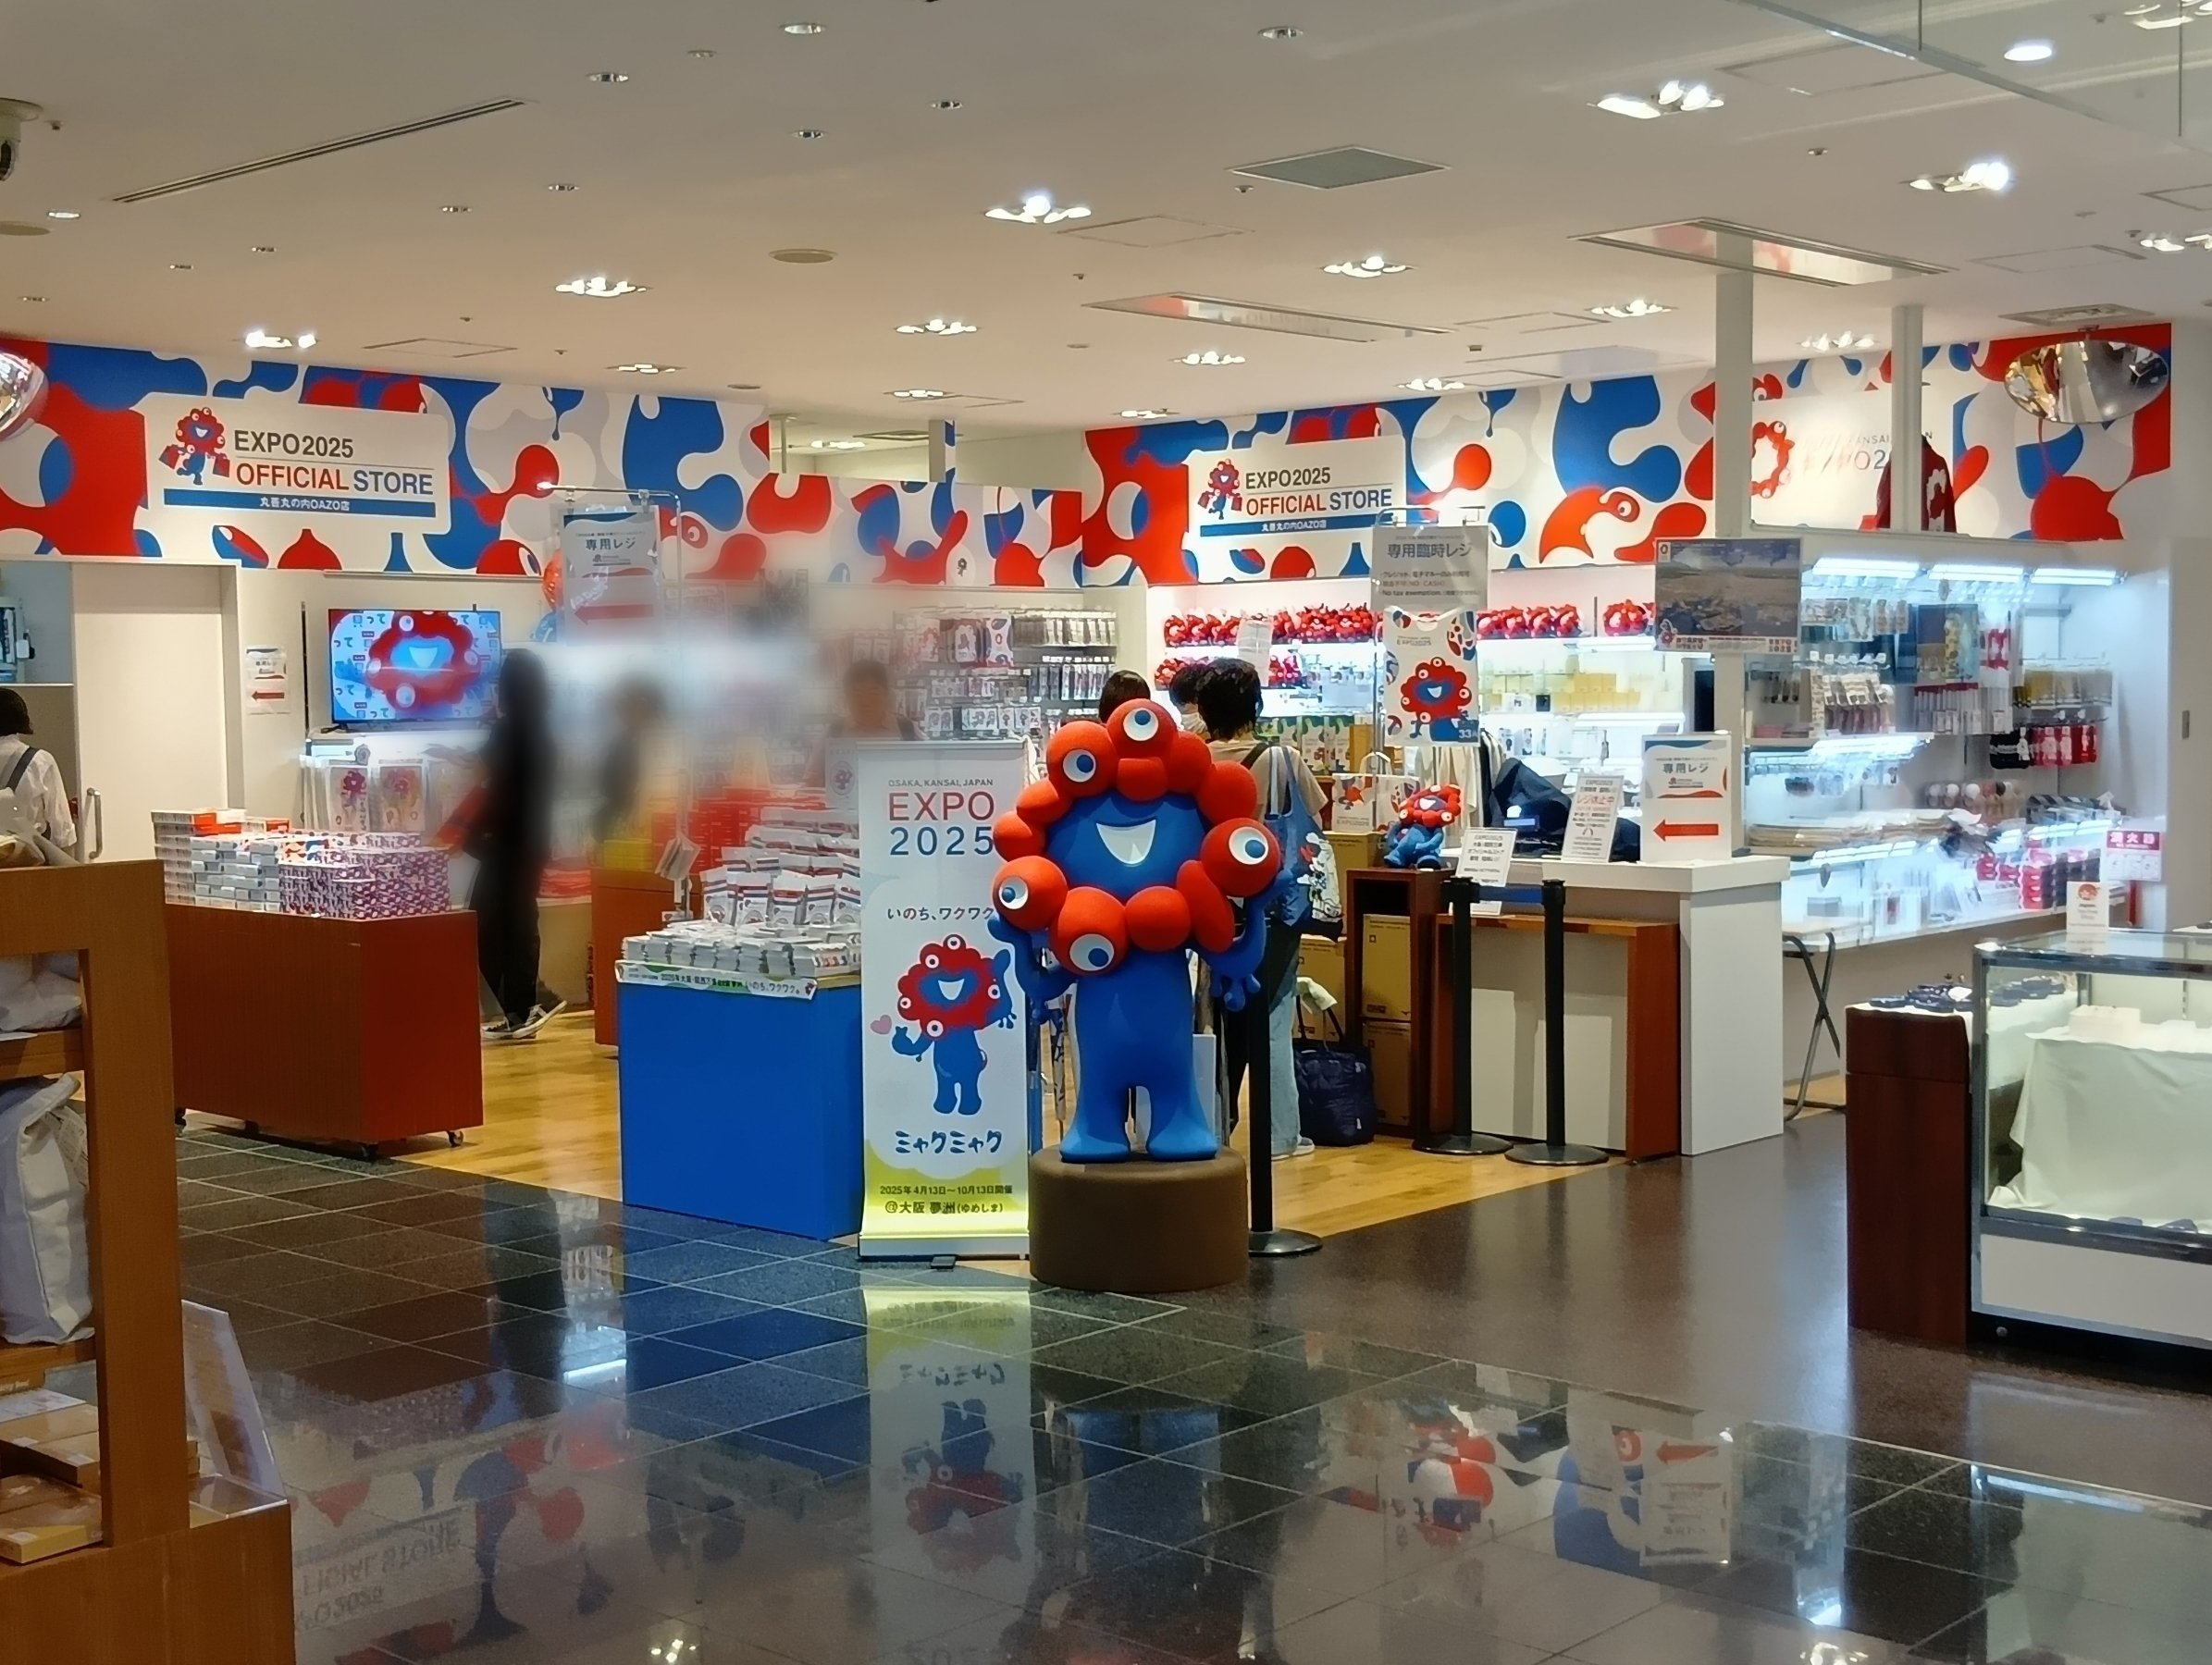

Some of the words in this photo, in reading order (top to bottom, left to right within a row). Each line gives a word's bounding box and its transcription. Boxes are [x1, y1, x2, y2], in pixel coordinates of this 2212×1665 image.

[234, 429, 353, 458] EXPO2025
[236, 462, 349, 491] OFFICIAL
[352, 471, 434, 495] STORE
[1245, 467, 1330, 489] EXPO2025
[260, 497, 350, 511] 丸善丸の内OAZO店
[1246, 494, 1327, 516] OFFICIAL
[1329, 488, 1392, 511] STORE
[586, 536, 636, 550] 専用レジ
[1388, 543, 1472, 559] 専用臨時レジ
[1663, 762, 1709, 773] 専用レジ
[888, 779, 922, 787] OSAKA,
[924, 779, 961, 787] KANSAI,
[963, 778, 994, 786] JAPAN
[889, 791, 995, 821] EXPO
[889, 826, 995, 856] 2025
[895, 1130, 1003, 1153] ミャクミャク
